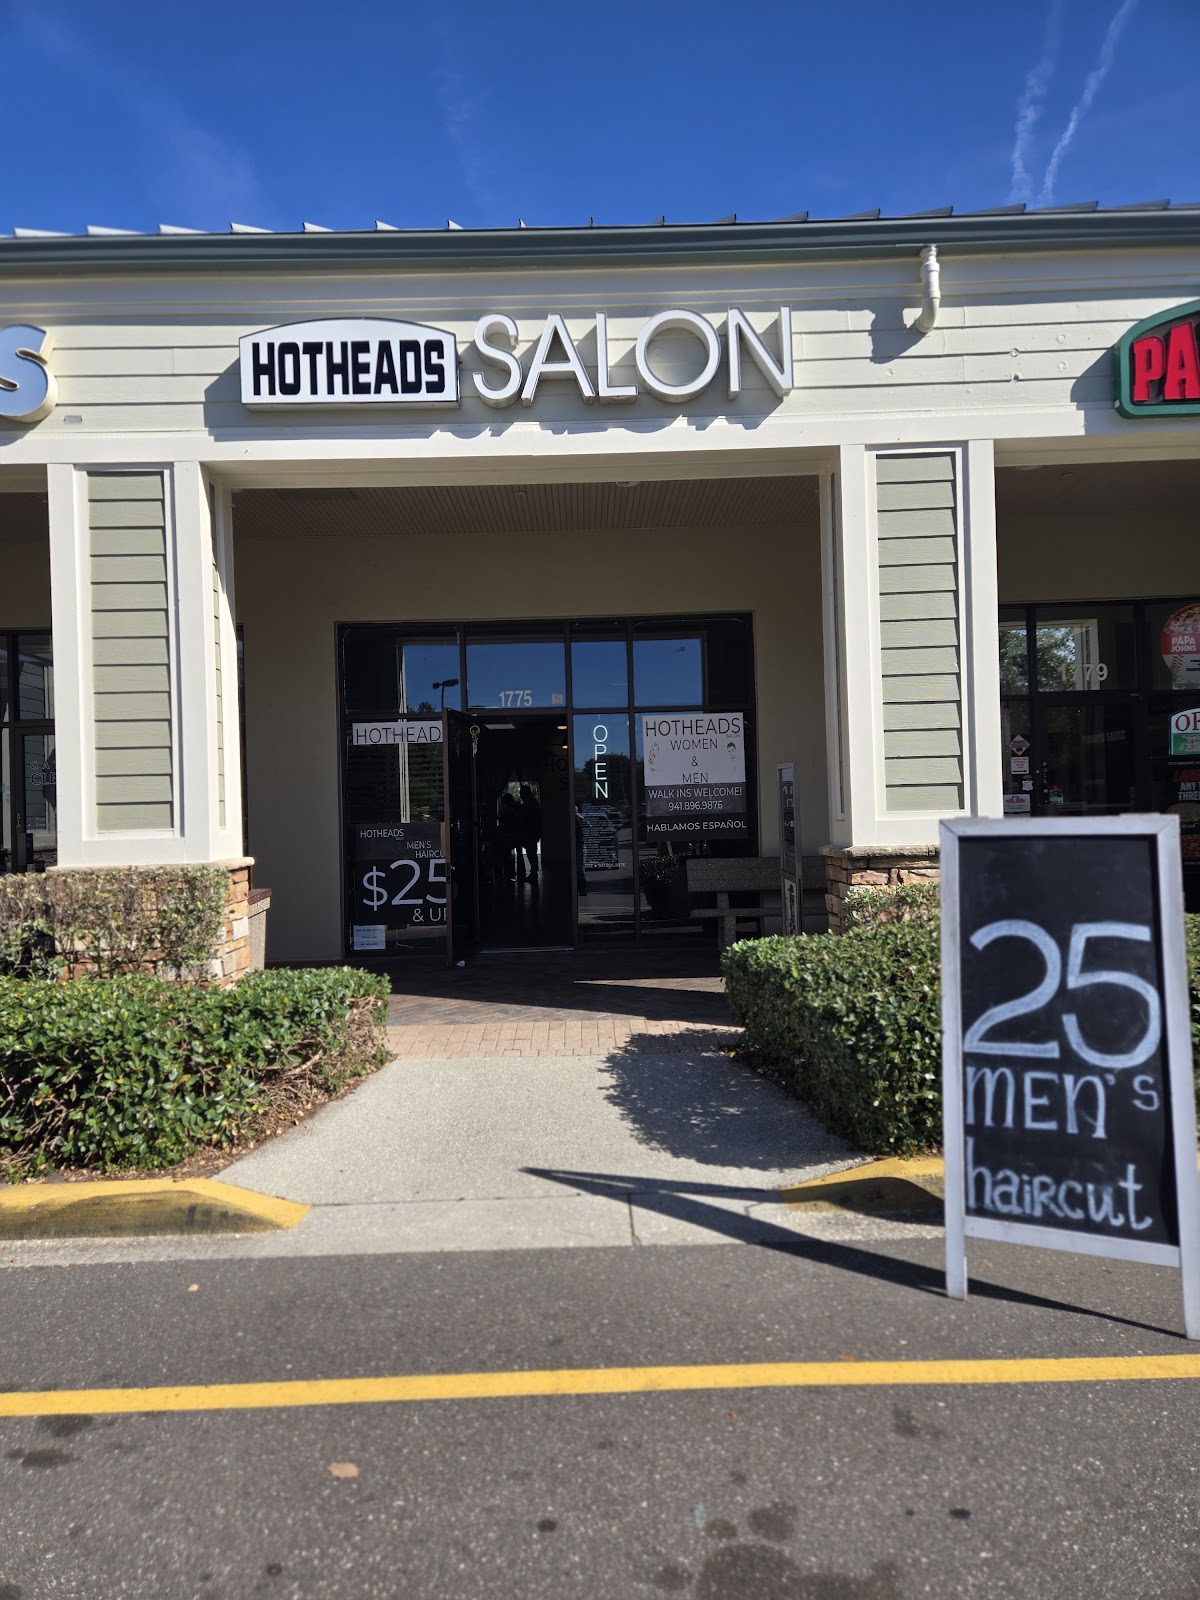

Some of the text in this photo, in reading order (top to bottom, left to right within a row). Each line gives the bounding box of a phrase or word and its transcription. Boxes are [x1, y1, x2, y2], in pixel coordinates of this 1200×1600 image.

[472, 305, 794, 408] SALON
[1132, 319, 1200, 403] PA
[252, 339, 445, 396] HOTHEADS
[1171, 635, 1197, 645] PAPA
[1170, 644, 1197, 653] JOHNS
[498, 690, 533, 708] 1775
[645, 717, 741, 737] HOTHEADS
[356, 726, 442, 744] HOTHEAD
[670, 738, 718, 751] WOMEN
[592, 724, 609, 800] OPEN
[691, 755, 699, 767] &
[682, 772, 709, 784] MEN
[648, 786, 743, 799] WALK INS WELCOME!
[668, 800, 724, 811] 941.896.9876
[646, 819, 747, 832] HABLAMOS ESPAÑOL
[360, 828, 405, 838] HOTHEADS
[406, 840, 432, 850] MEN'S
[412, 907, 425, 922] &
[964, 919, 1162, 1069] 25
